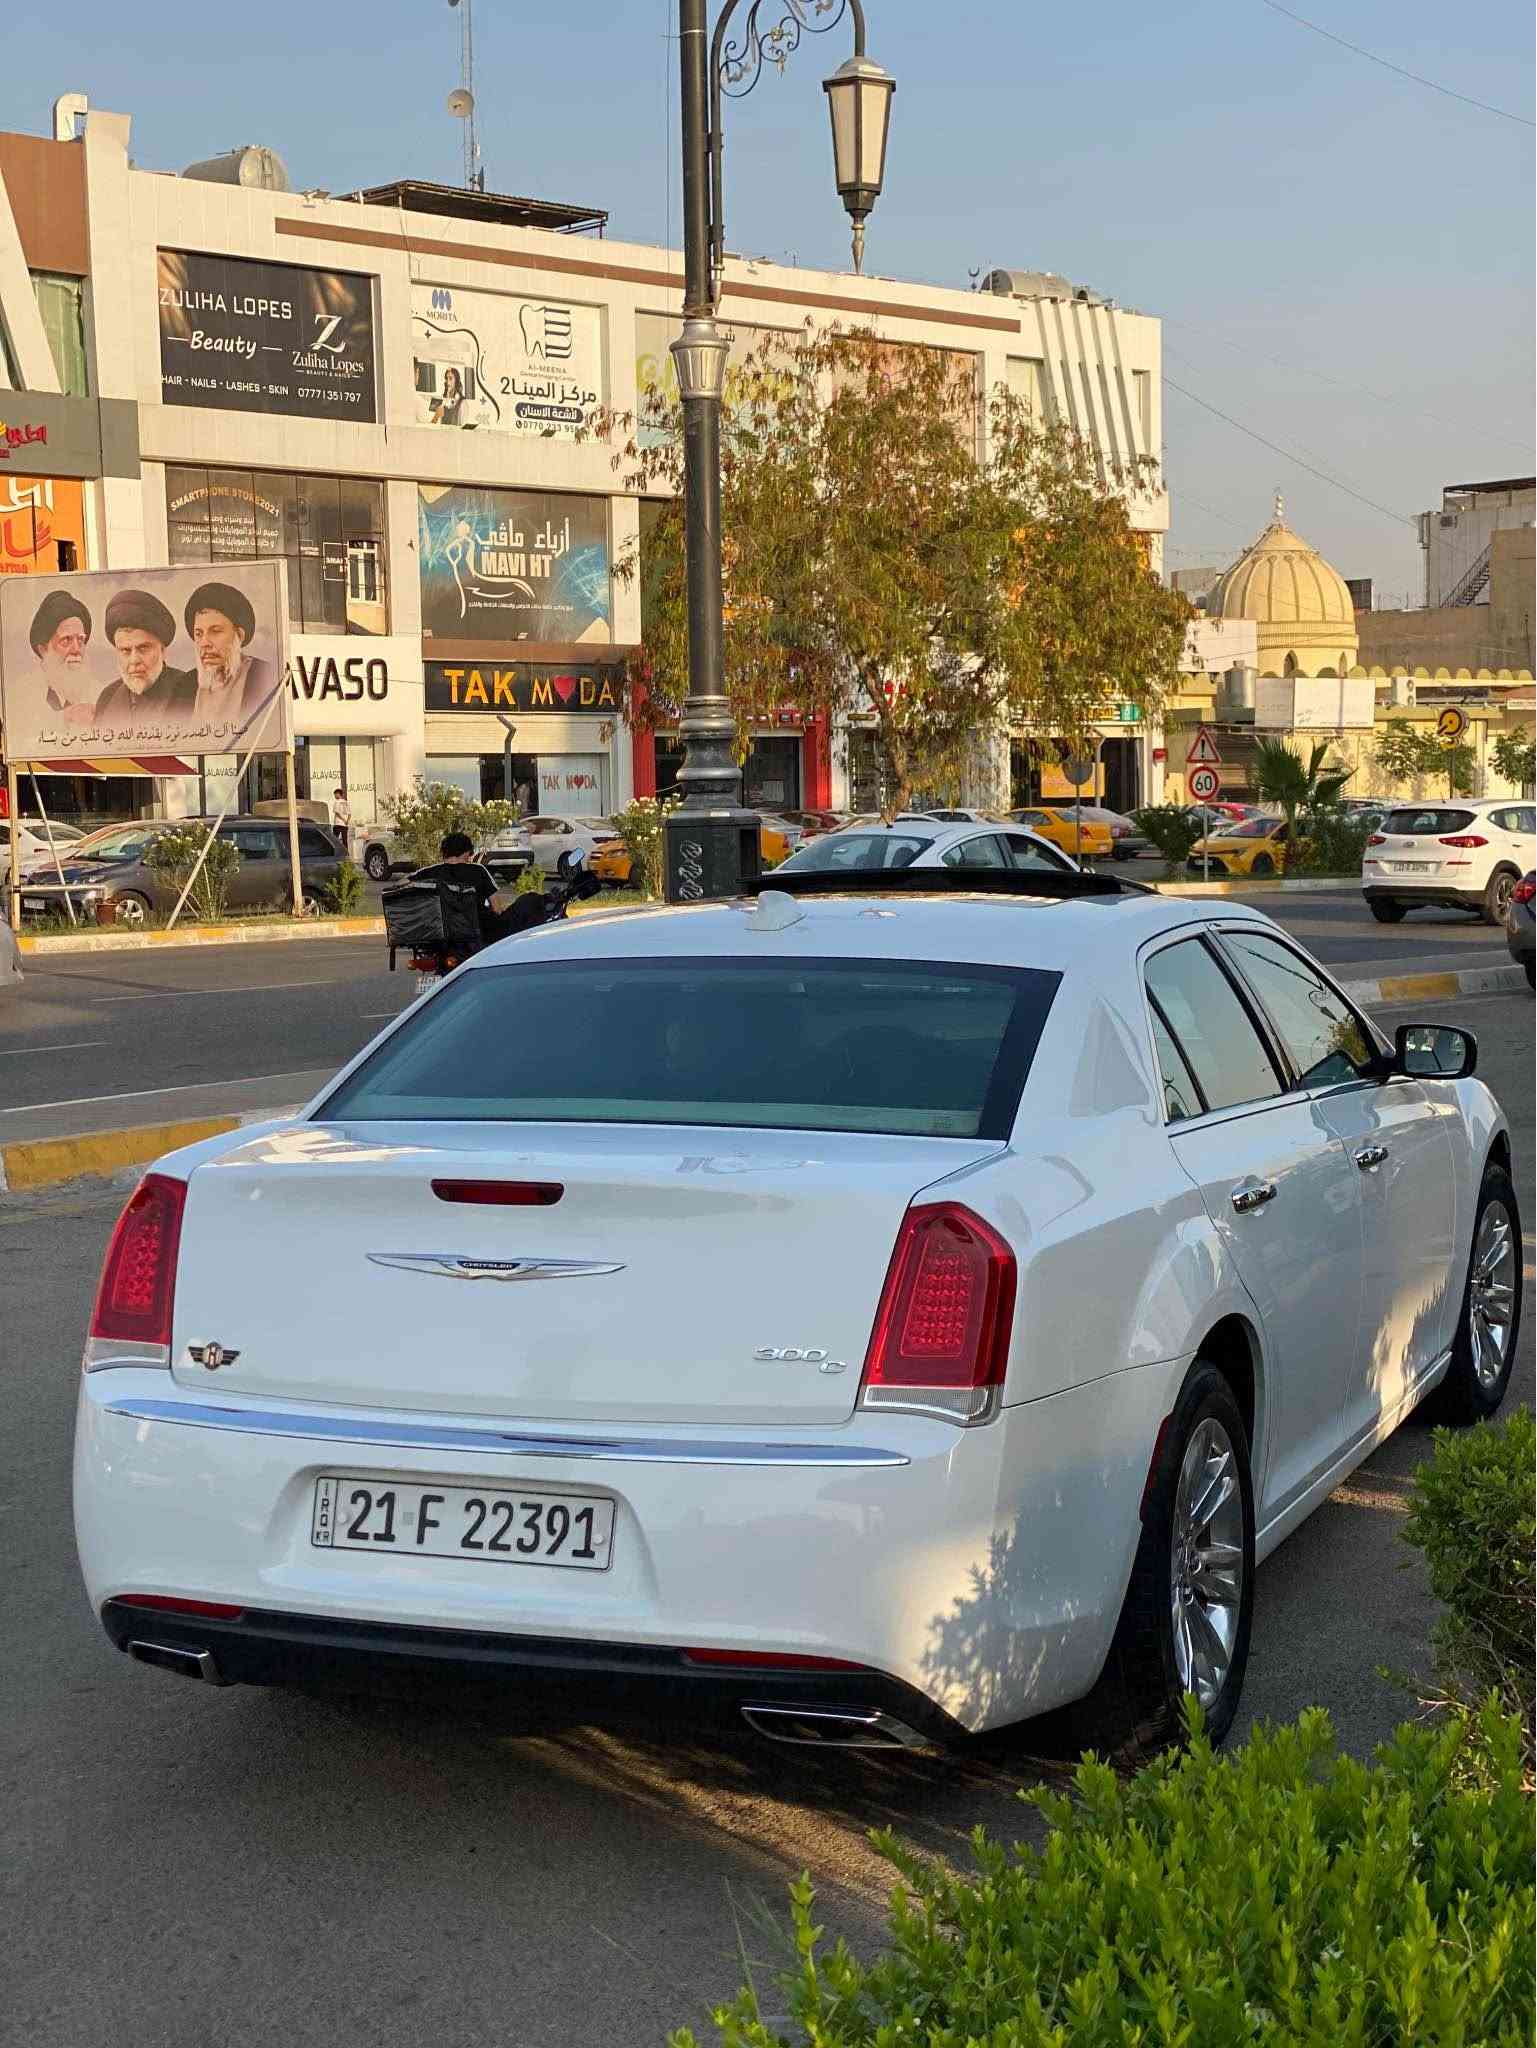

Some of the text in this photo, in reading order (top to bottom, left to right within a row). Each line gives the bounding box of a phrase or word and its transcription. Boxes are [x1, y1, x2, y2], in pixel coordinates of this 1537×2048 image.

[159, 287, 292, 319] ZULIHA LOPES
[427, 310, 458, 322] MORITA
[190, 330, 257, 360] Beauty
[292, 350, 365, 374] Zuliha Lopes
[161, 374, 289, 395] HAIR NAILS LASHES SKIN
[297, 387, 362, 403] 07771351797
[558, 384, 597, 406] مركز
[482, 551, 552, 577] MAVI HT
[444, 668, 517, 706] TAK
[60, 729, 78, 747] من
[117, 727, 134, 741] الله
[542, 775, 560, 790] TAK
[1196, 775, 1212, 792] 60
[347, 1489, 596, 1559] 21 F 22391
